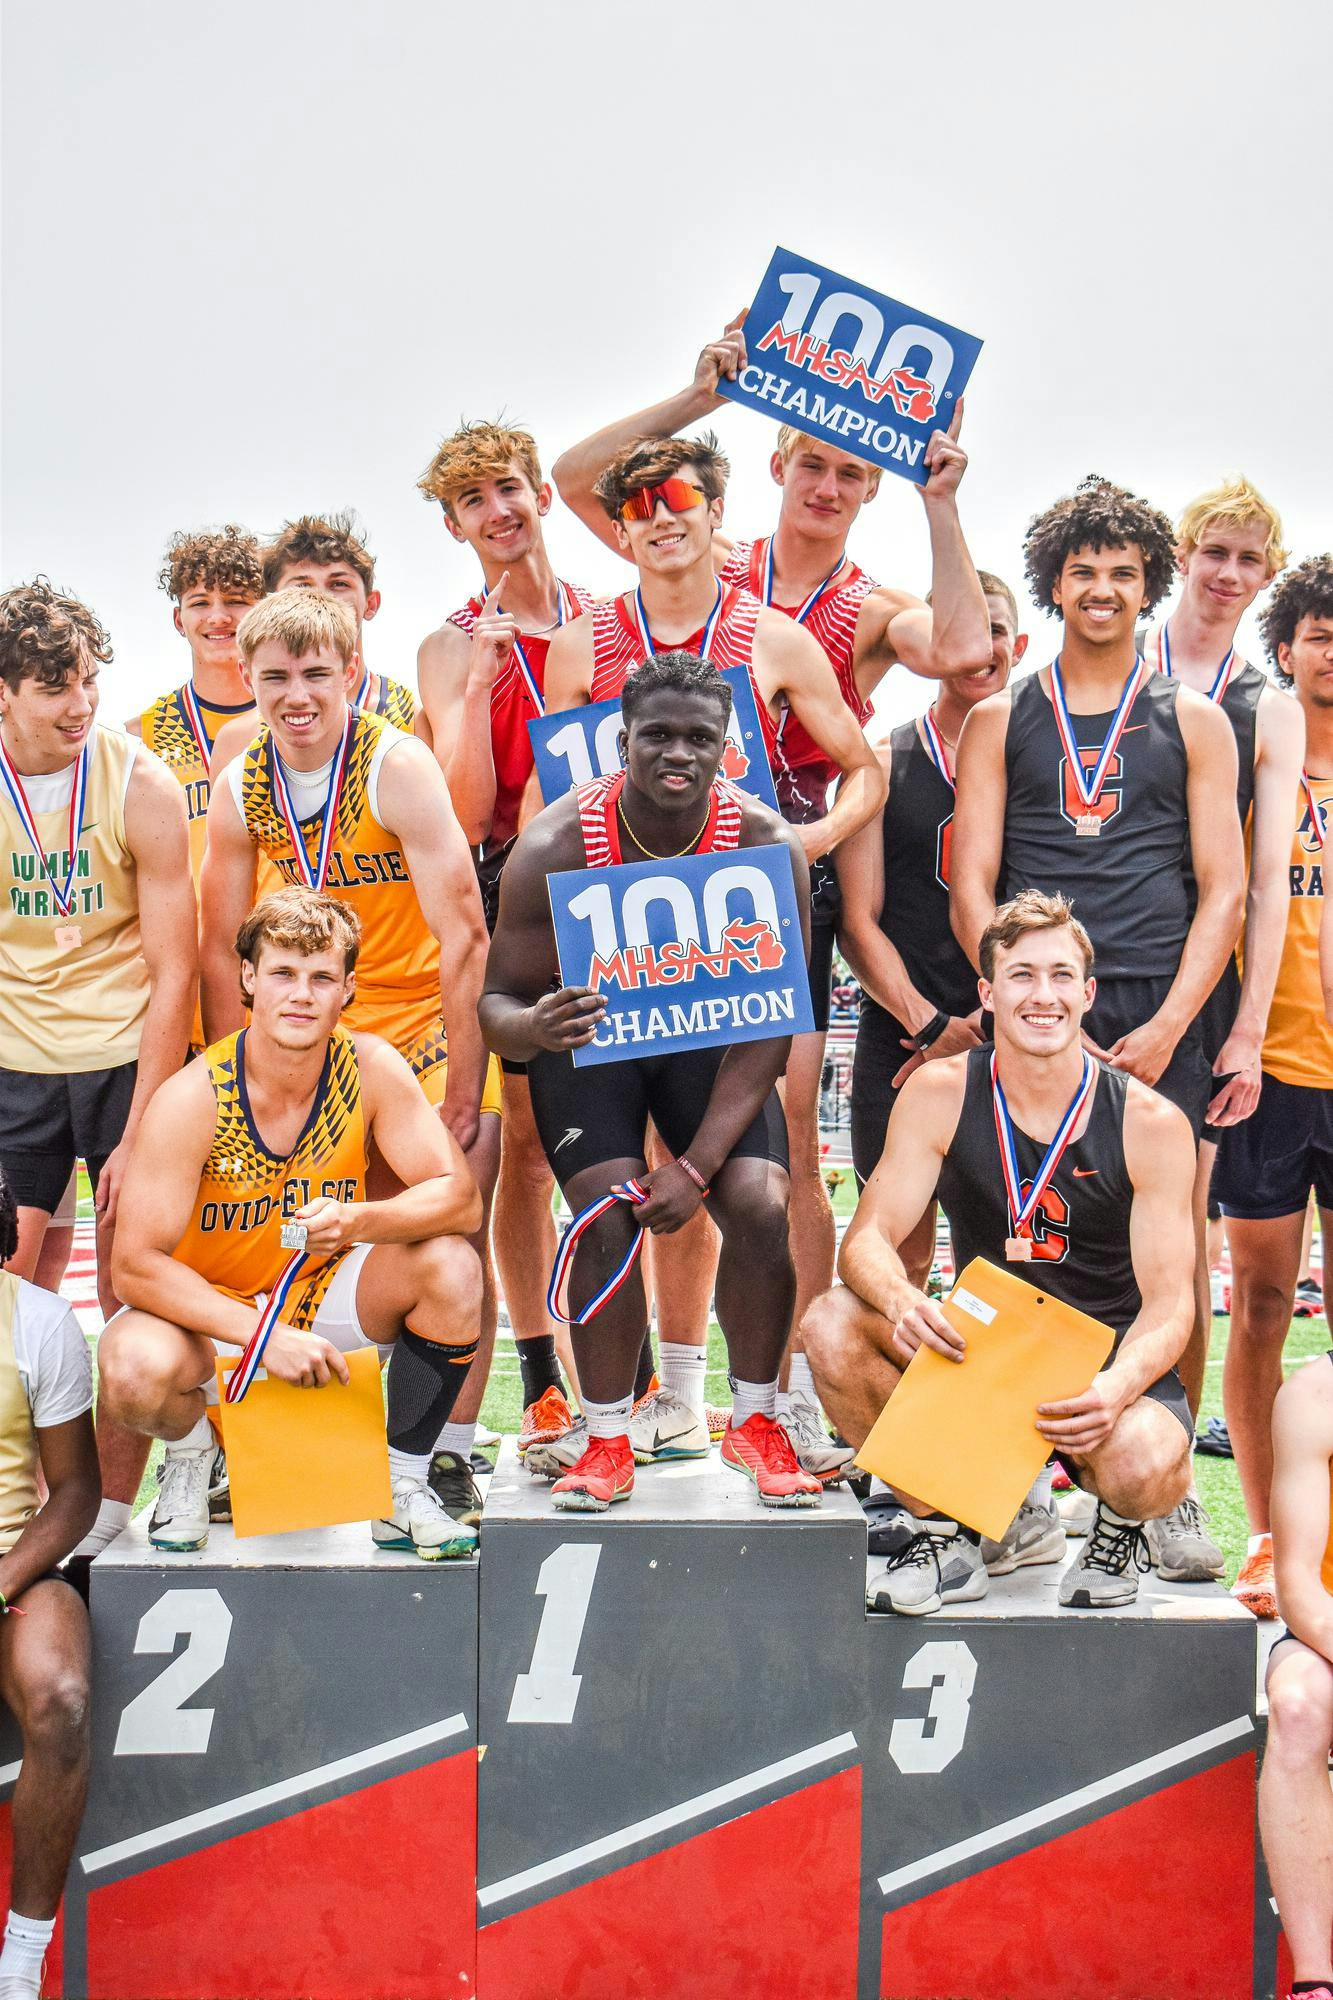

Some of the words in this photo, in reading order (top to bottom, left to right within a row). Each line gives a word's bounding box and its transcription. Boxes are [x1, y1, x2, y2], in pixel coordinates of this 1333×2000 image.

[756, 320, 911, 417] MHSAA
[779, 273, 954, 405] 100
[738, 365, 925, 467] CHAMPION
[568, 866, 781, 963] 100
[588, 937, 762, 993] MHSAA
[589, 988, 795, 1047] CHAMPION
[114, 1588, 233, 1756] 2
[507, 1543, 602, 1723] 1
[888, 1640, 978, 1774] 3
